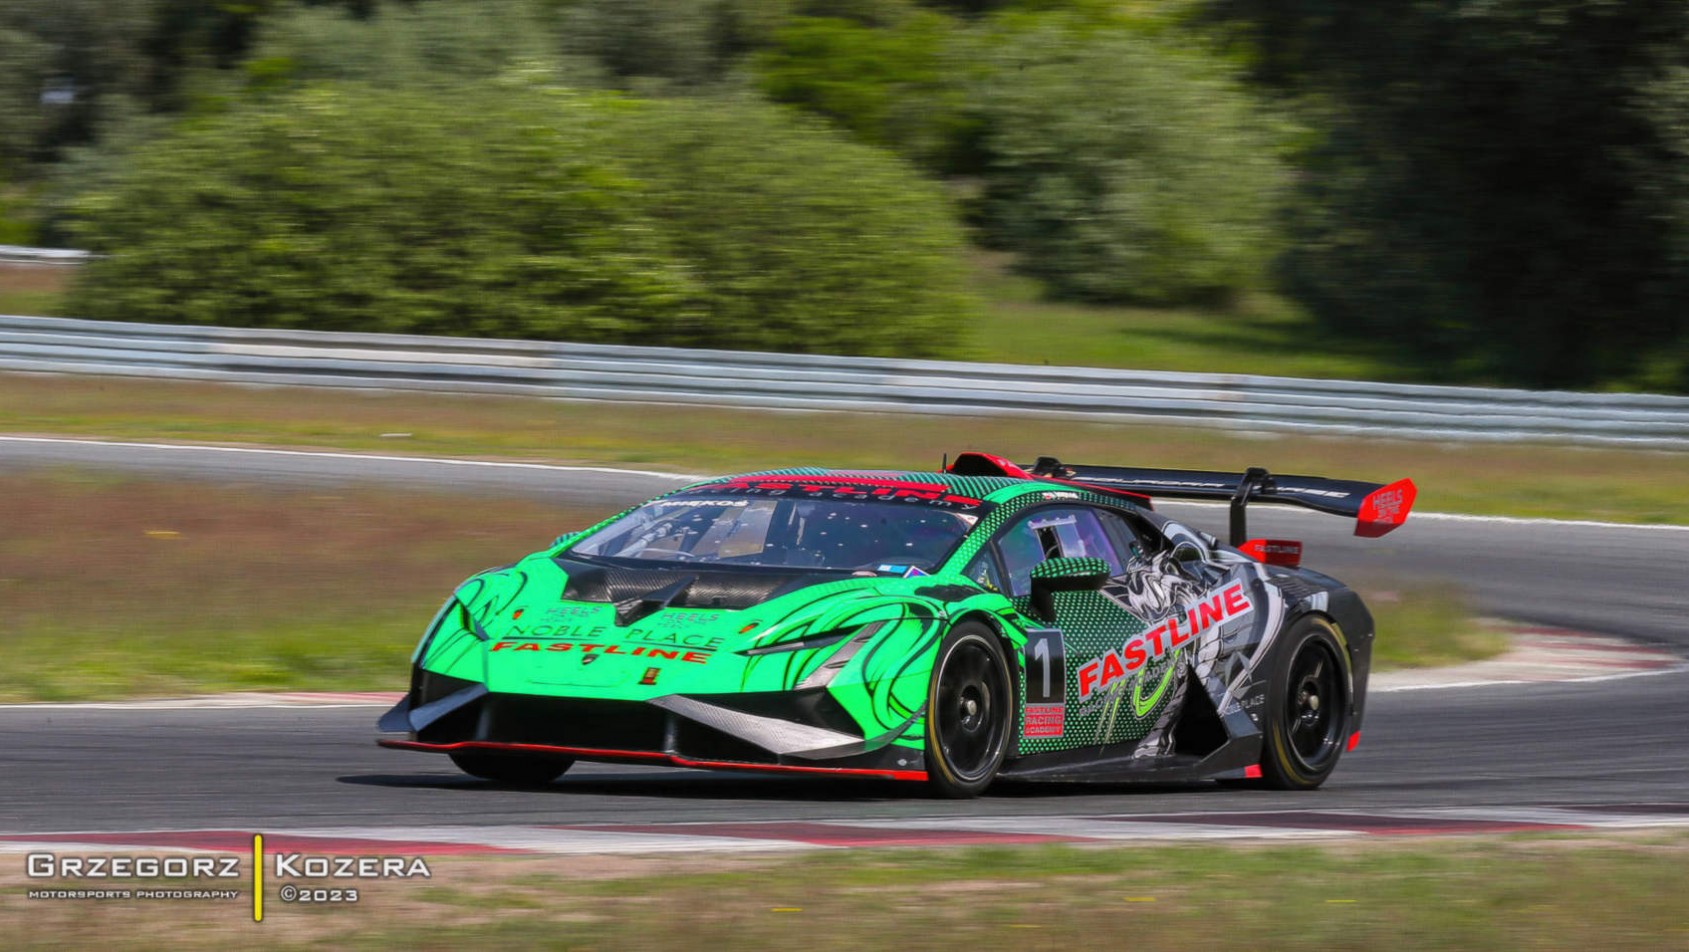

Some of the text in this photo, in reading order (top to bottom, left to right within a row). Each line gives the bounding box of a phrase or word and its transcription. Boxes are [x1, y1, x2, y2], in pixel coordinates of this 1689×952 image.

[503, 624, 726, 650] NOBLE PLACE
[1077, 583, 1251, 698] FASTLINE
[490, 641, 712, 664] FASTLINE
[1034, 638, 1051, 698] 1
[1024, 715, 1062, 725] RACING
